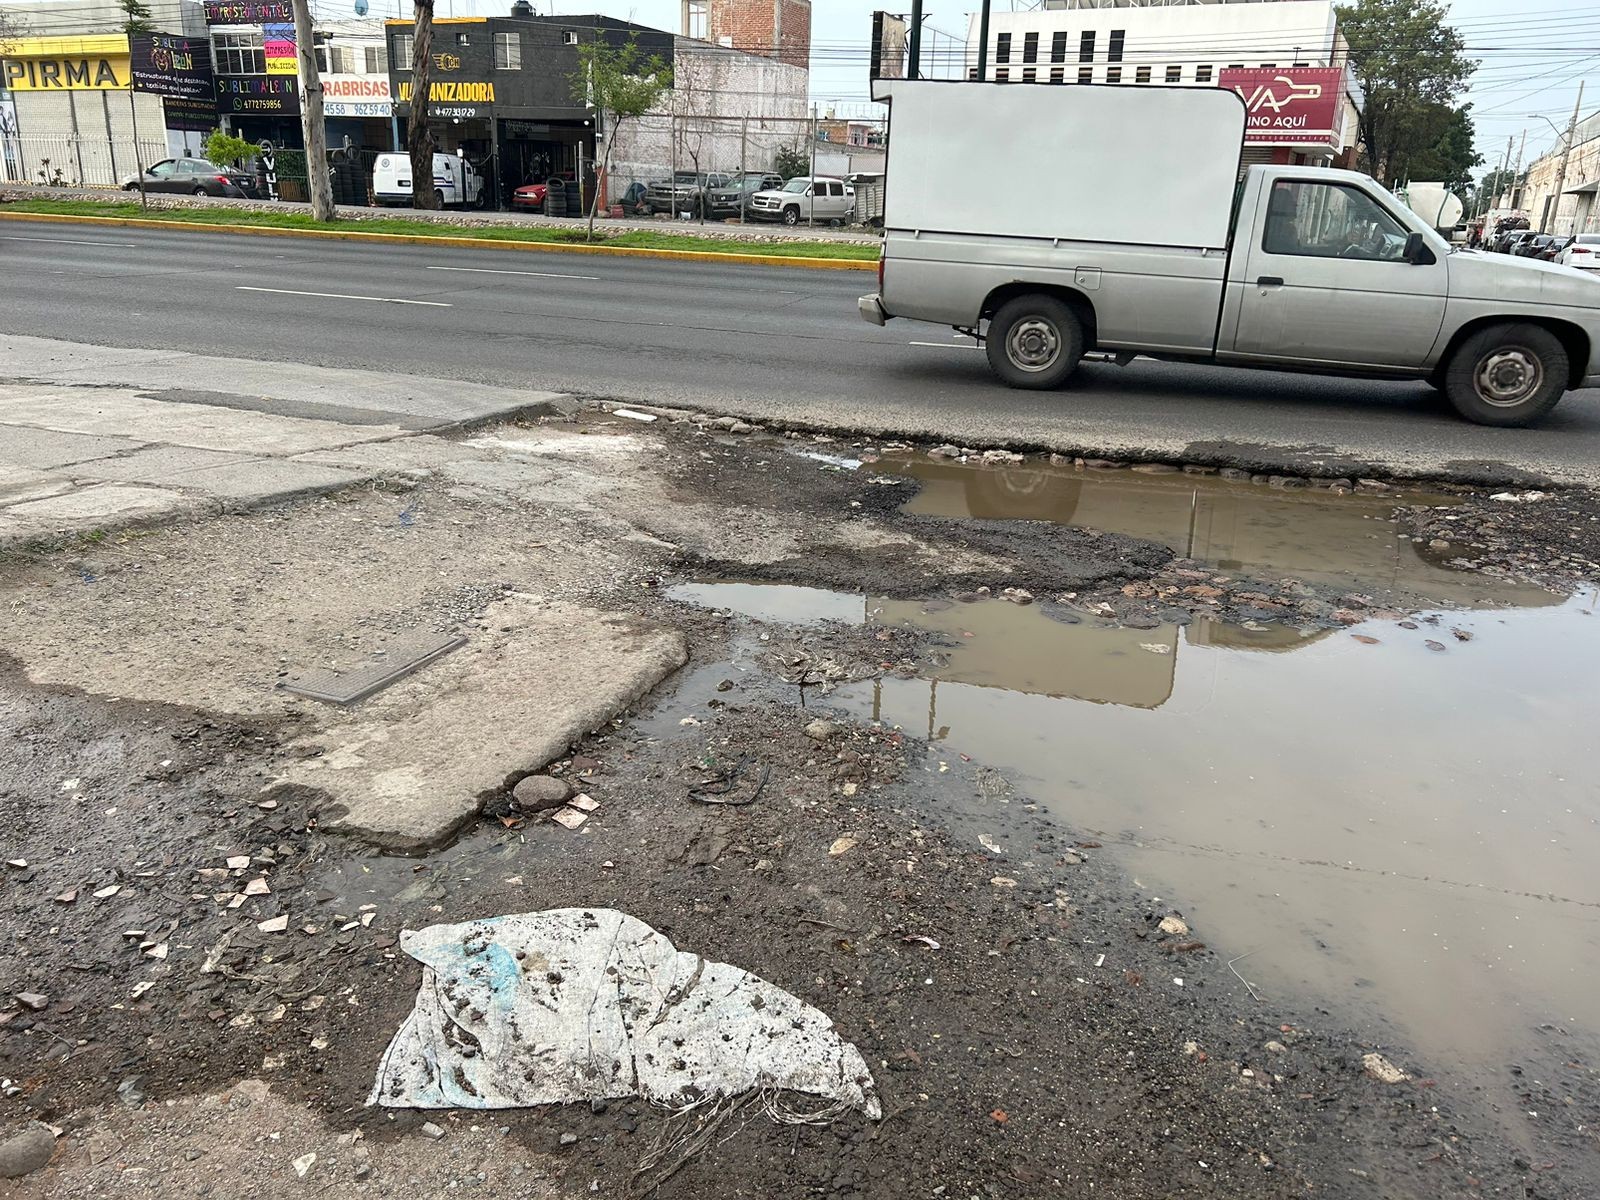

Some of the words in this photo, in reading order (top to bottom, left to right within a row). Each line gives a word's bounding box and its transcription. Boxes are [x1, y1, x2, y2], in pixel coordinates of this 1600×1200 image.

[7, 59, 119, 88] PIRMA
[267, 62, 297, 70] PUBLICIDAD
[398, 82, 495, 102] VUANIZADORA
[1273, 114, 1307, 128] AQUÍ
